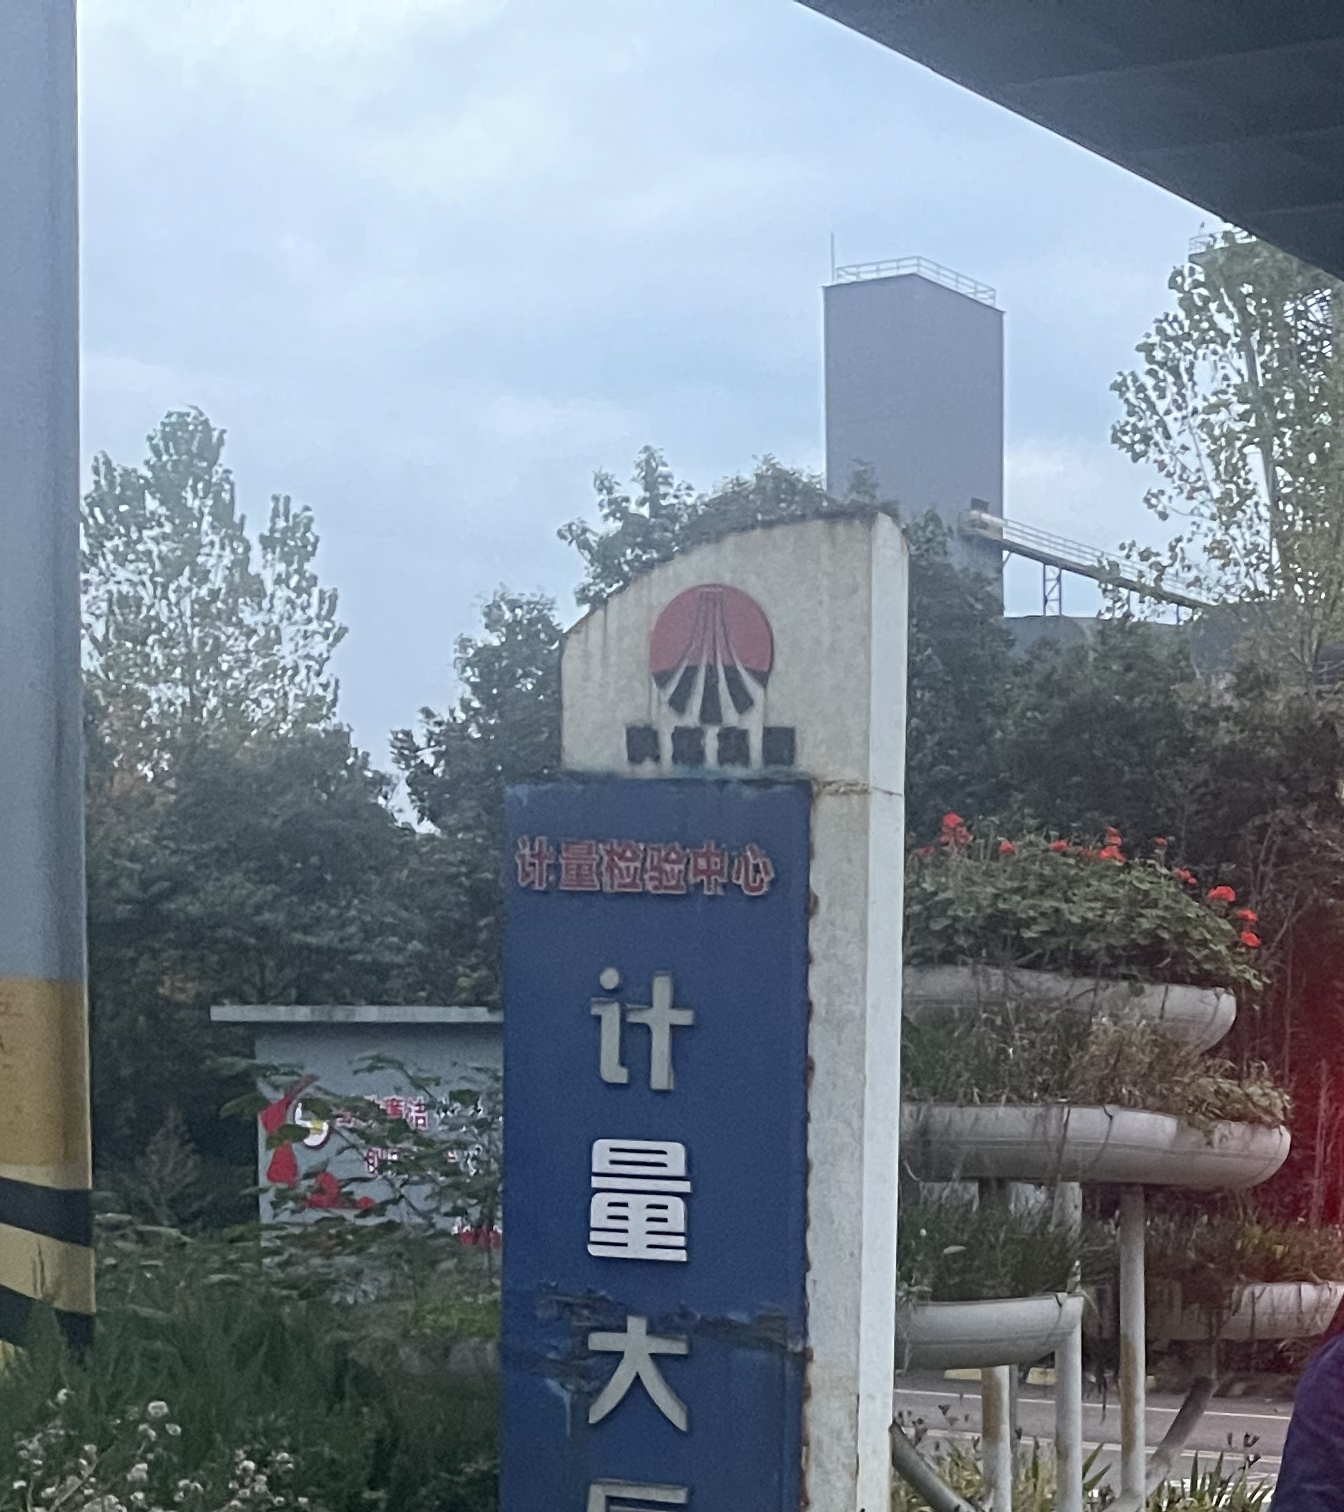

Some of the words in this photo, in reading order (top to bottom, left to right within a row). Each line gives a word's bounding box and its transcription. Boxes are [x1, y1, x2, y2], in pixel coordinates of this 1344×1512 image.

[515, 835, 776, 897] 计量检验中心
